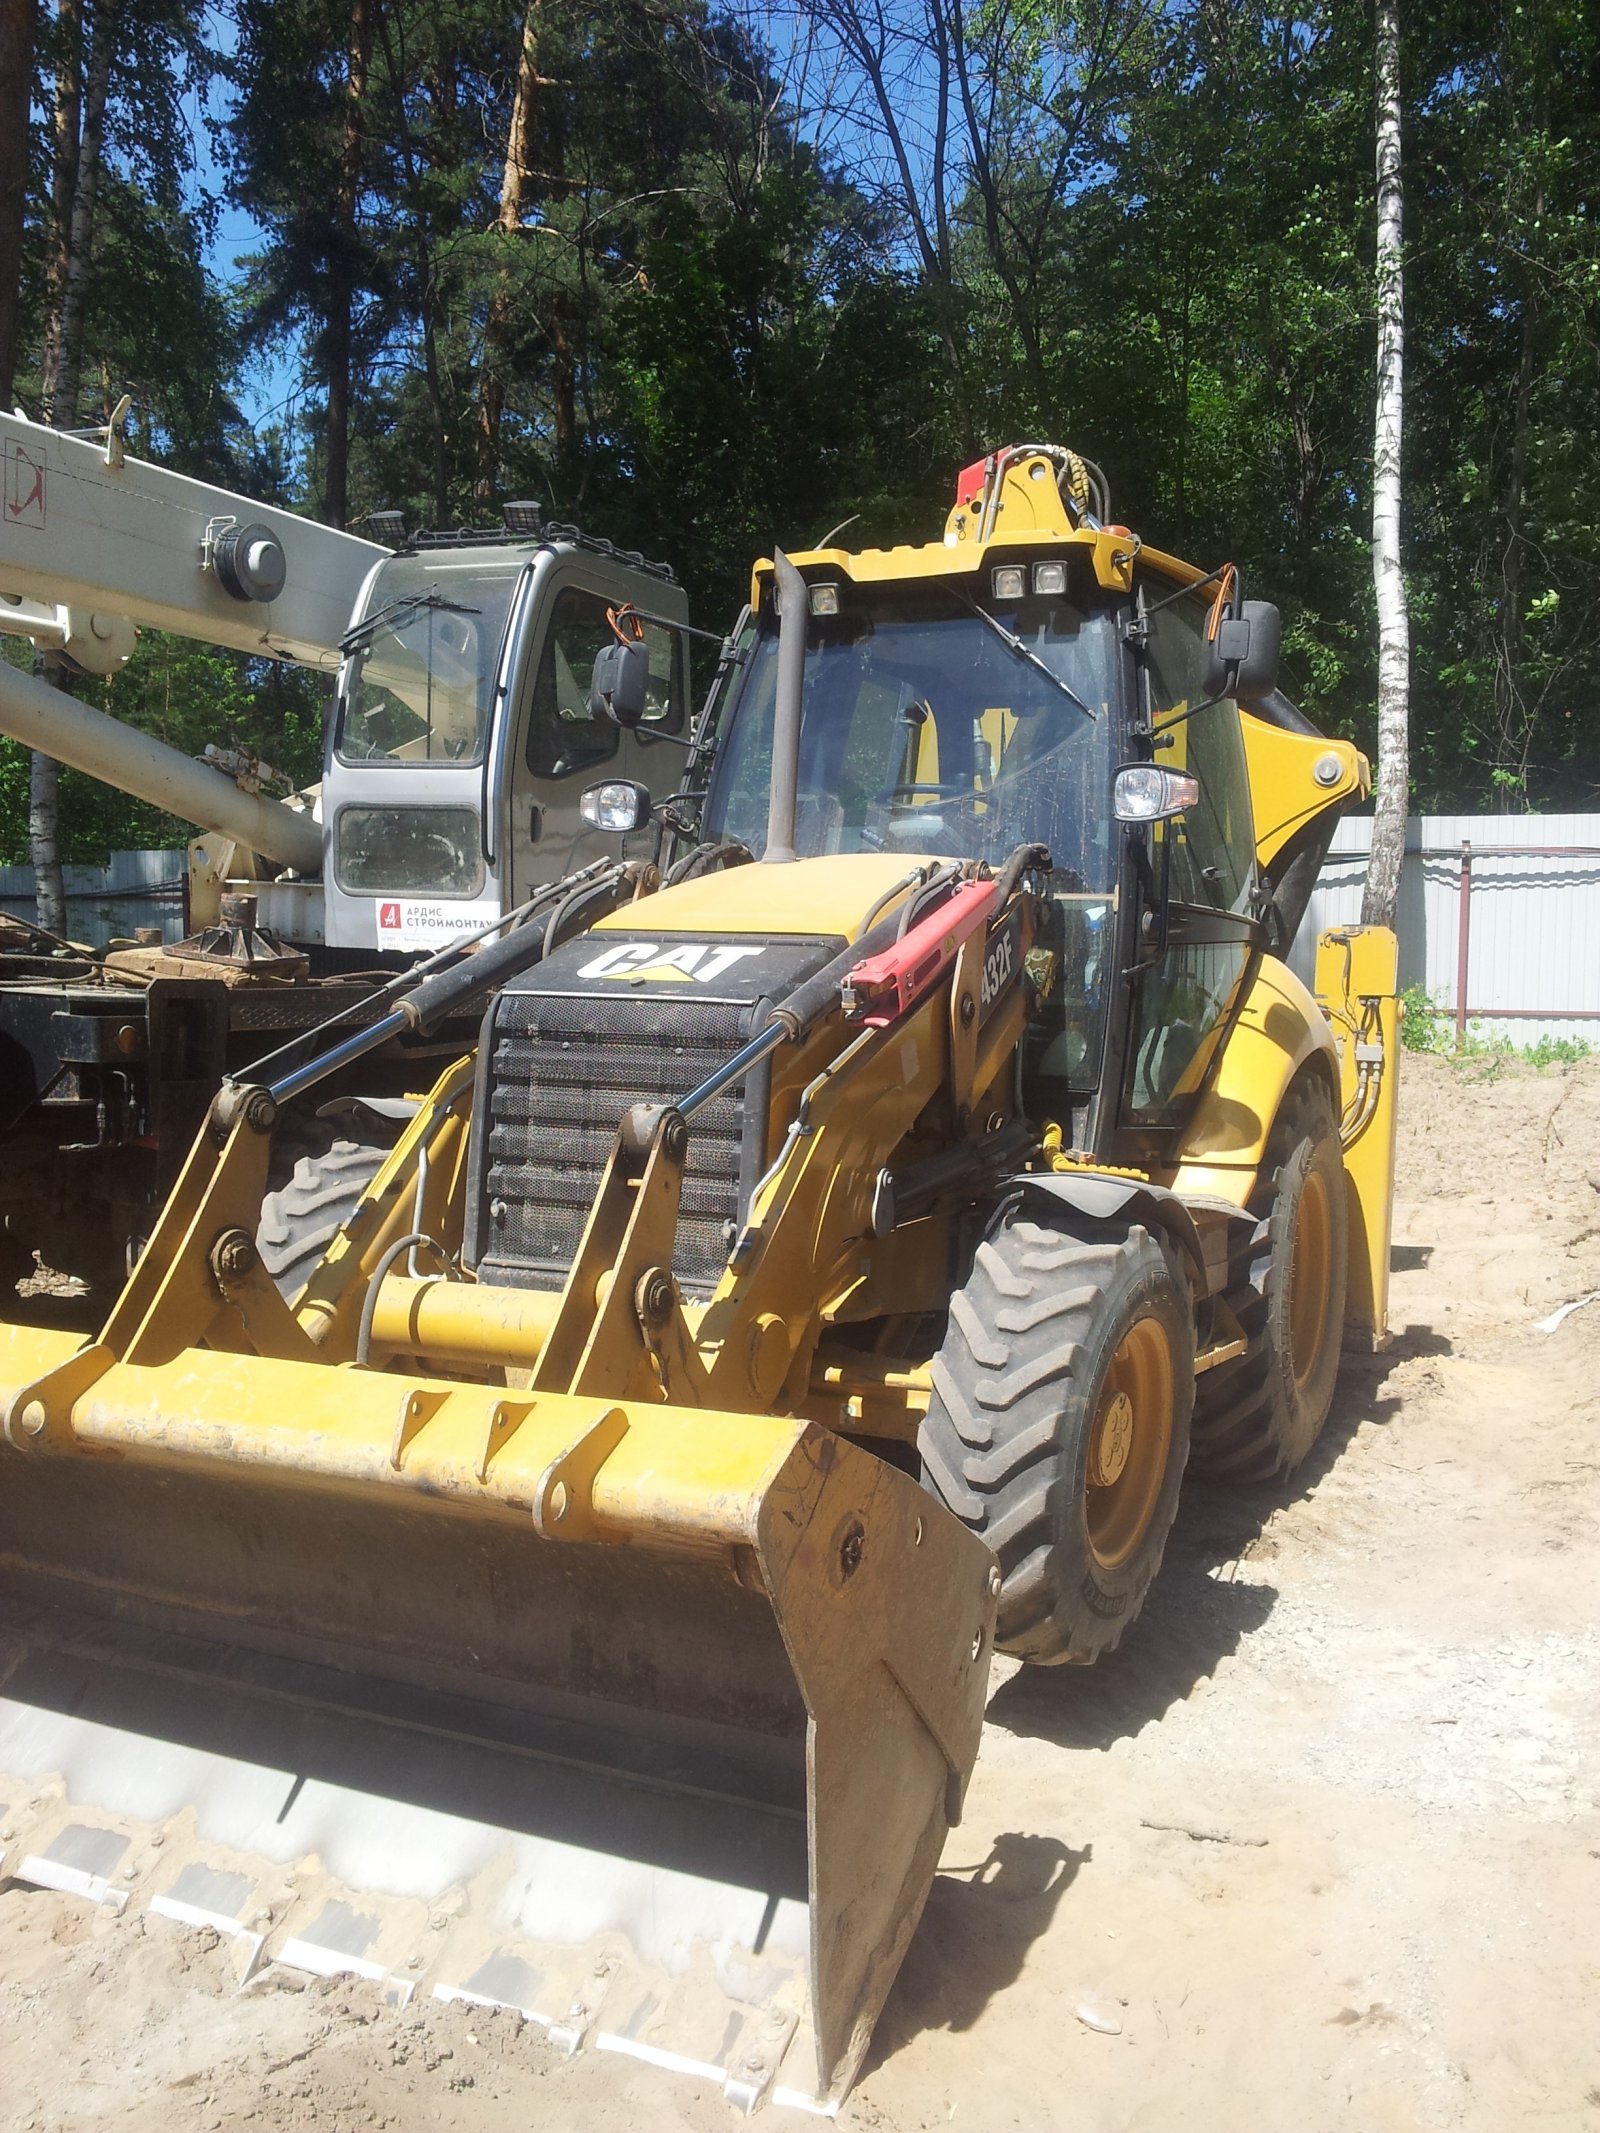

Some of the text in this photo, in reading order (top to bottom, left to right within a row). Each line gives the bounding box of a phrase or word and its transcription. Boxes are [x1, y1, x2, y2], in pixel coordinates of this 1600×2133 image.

[407, 907, 443, 918] АРДИС
[576, 943, 767, 983] CAT
[981, 930, 1012, 1005] 432F
